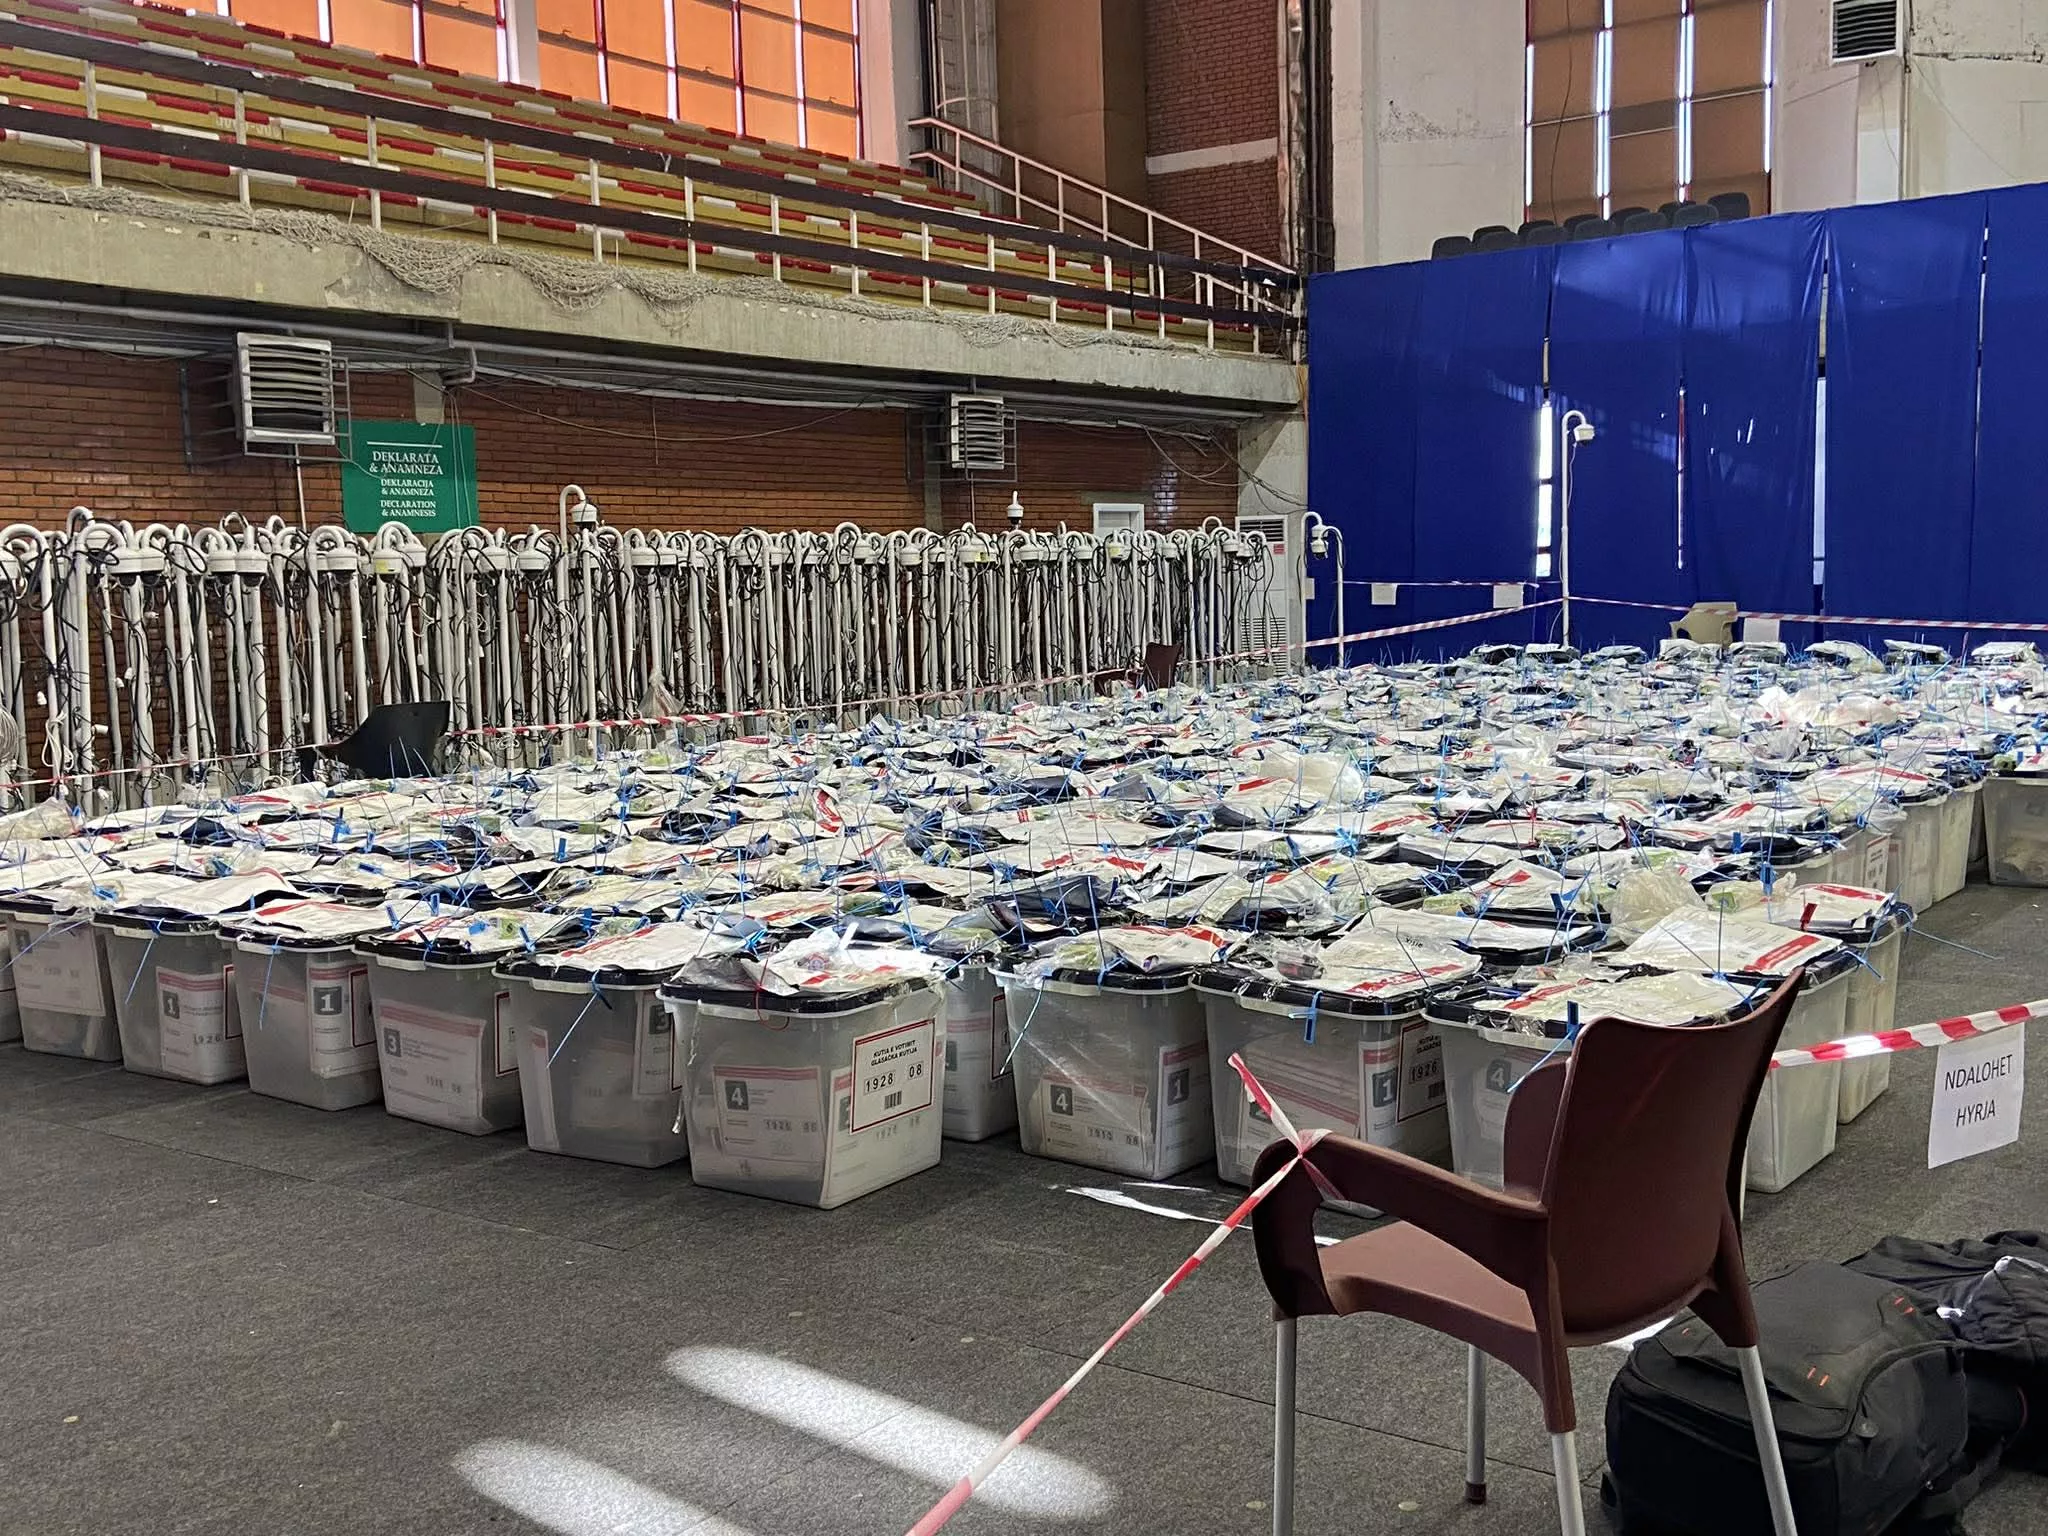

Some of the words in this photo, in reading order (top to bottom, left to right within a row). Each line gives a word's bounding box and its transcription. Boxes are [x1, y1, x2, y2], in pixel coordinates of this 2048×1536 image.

[373, 451, 438, 463] DEKLARATA
[369, 464, 379, 473] &
[380, 463, 443, 475] ANAMNEZA
[381, 479, 433, 488] DEKLARACIJA
[382, 487, 389, 495] &
[390, 488, 434, 496] ANAMNEZA
[381, 500, 436, 508] DECLARATION
[382, 508, 389, 516] &
[390, 509, 436, 517] ANAMNESIS
[320, 994, 334, 1011] 1
[388, 1034, 396, 1052] 3
[873, 1048, 889, 1058] KUTIA
[896, 1040, 916, 1051] VOTIMIT
[899, 1047, 917, 1058] KUTIJA
[866, 1073, 894, 1092] 1928
[909, 1064, 922, 1078] 08
[1411, 1063, 1438, 1082] 1926
[1491, 1067, 1505, 1088] 4
[1945, 1054, 2013, 1091] NDALOHET
[731, 1087, 744, 1106] 4
[1056, 1093, 1068, 1111] 4
[1956, 1100, 1996, 1127] HYRJA
